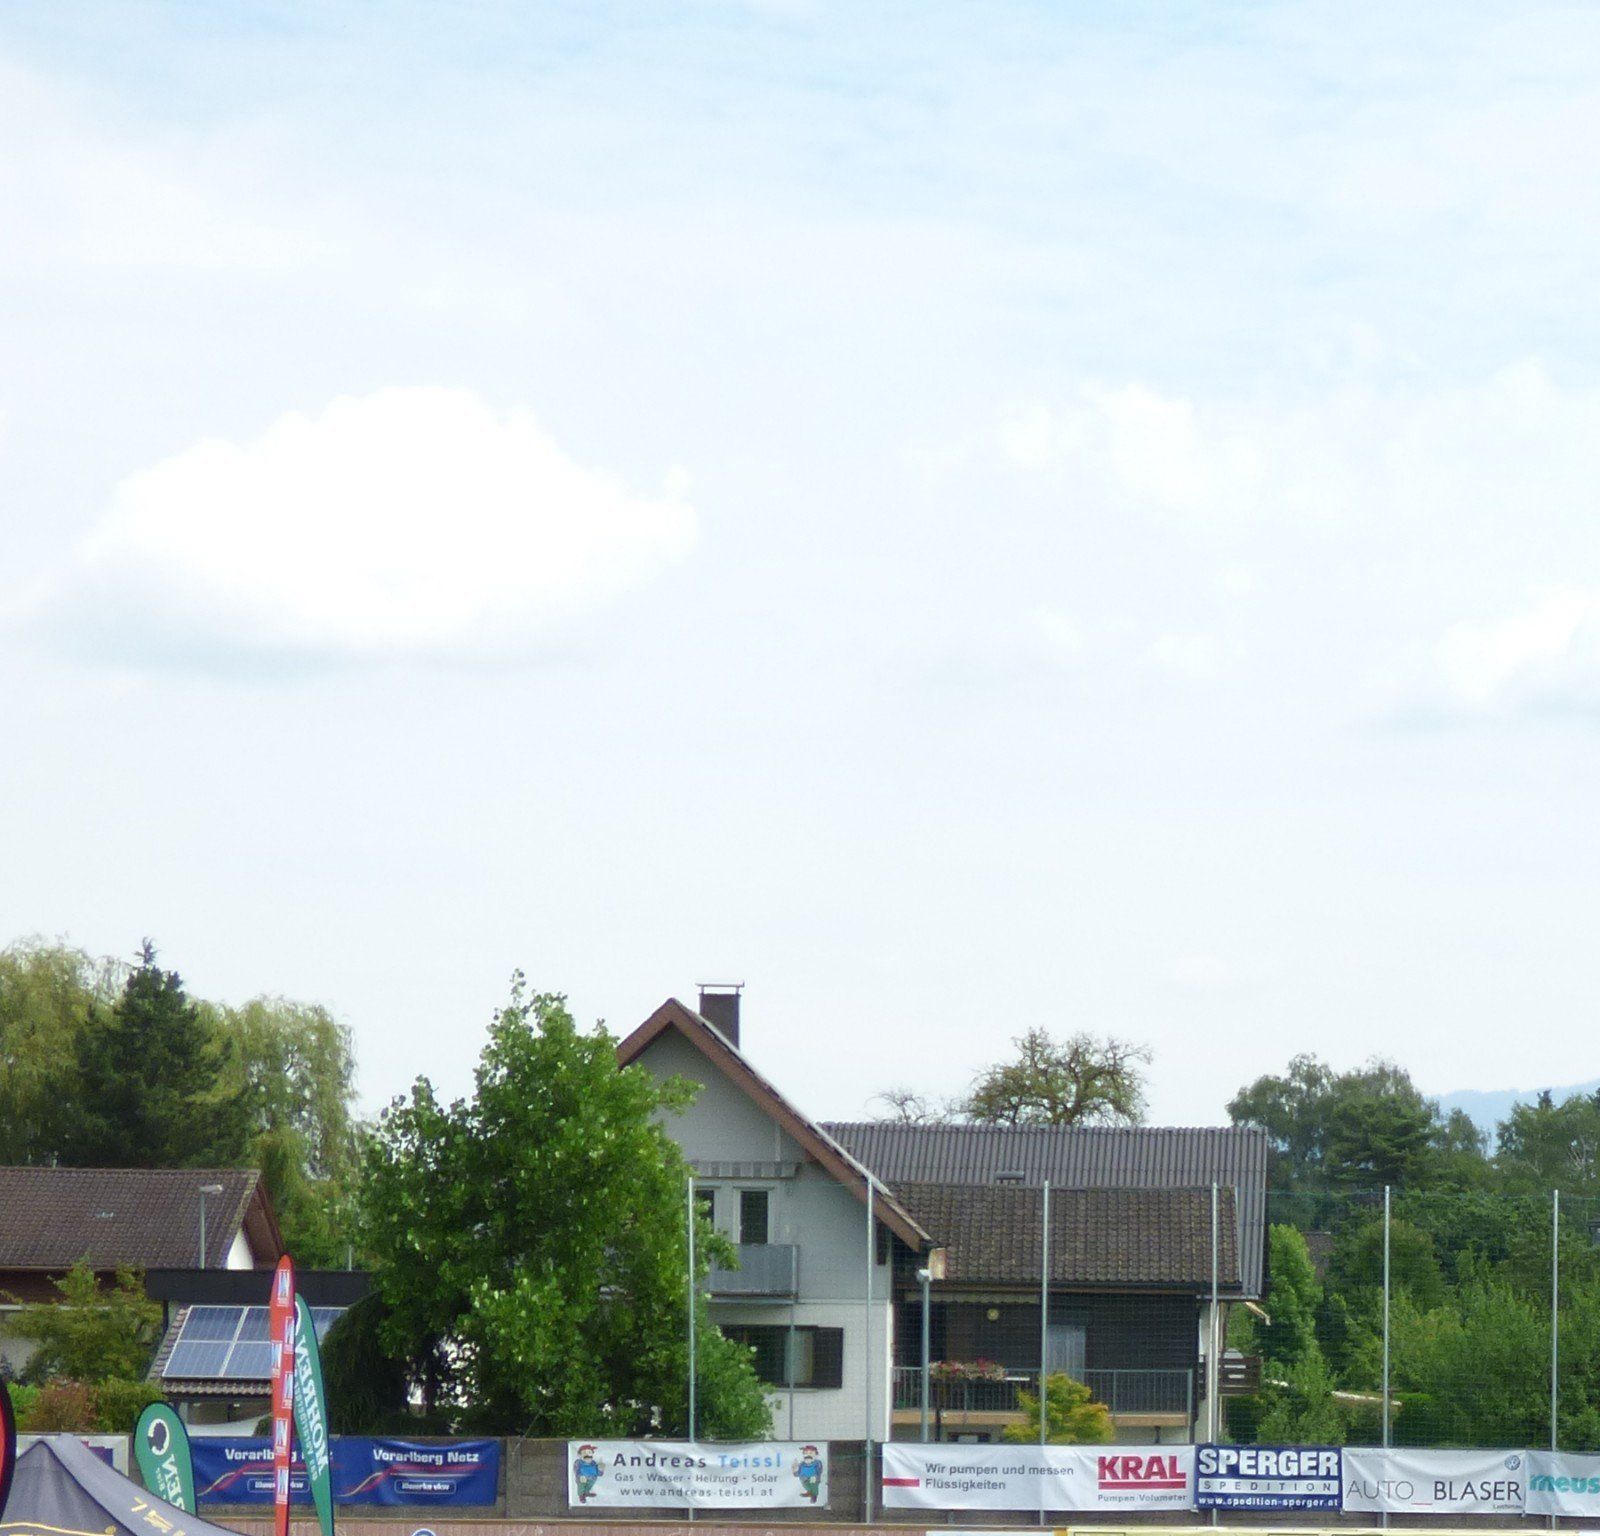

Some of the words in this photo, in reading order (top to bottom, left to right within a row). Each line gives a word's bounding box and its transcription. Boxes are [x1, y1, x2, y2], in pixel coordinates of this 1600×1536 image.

[225, 1448, 297, 1464] Vorarlbg
[373, 1449, 443, 1465] Vorarlberg
[447, 1451, 480, 1463] Netz
[613, 1453, 707, 1468] Andreas
[718, 1452, 782, 1468] Teissl
[1198, 1448, 1339, 1476] SPERGER
[925, 1463, 945, 1475] Wir
[949, 1465, 999, 1477] pumpen
[1002, 1464, 1025, 1476] und
[1028, 1466, 1074, 1476] messen
[1098, 1455, 1187, 1480] KRAL
[615, 1472, 634, 1483] Gas
[647, 1472, 683, 1484] Wasser
[696, 1473, 739, 1486] Heizung
[751, 1473, 778, 1484] Solar
[925, 1477, 1007, 1491] Flüssigkeiten
[1203, 1480, 1331, 1492] SPEDITION
[1098, 1493, 1136, 1504] Pumpen
[1198, 1496, 1338, 1508] www.spedition-sperger.at
